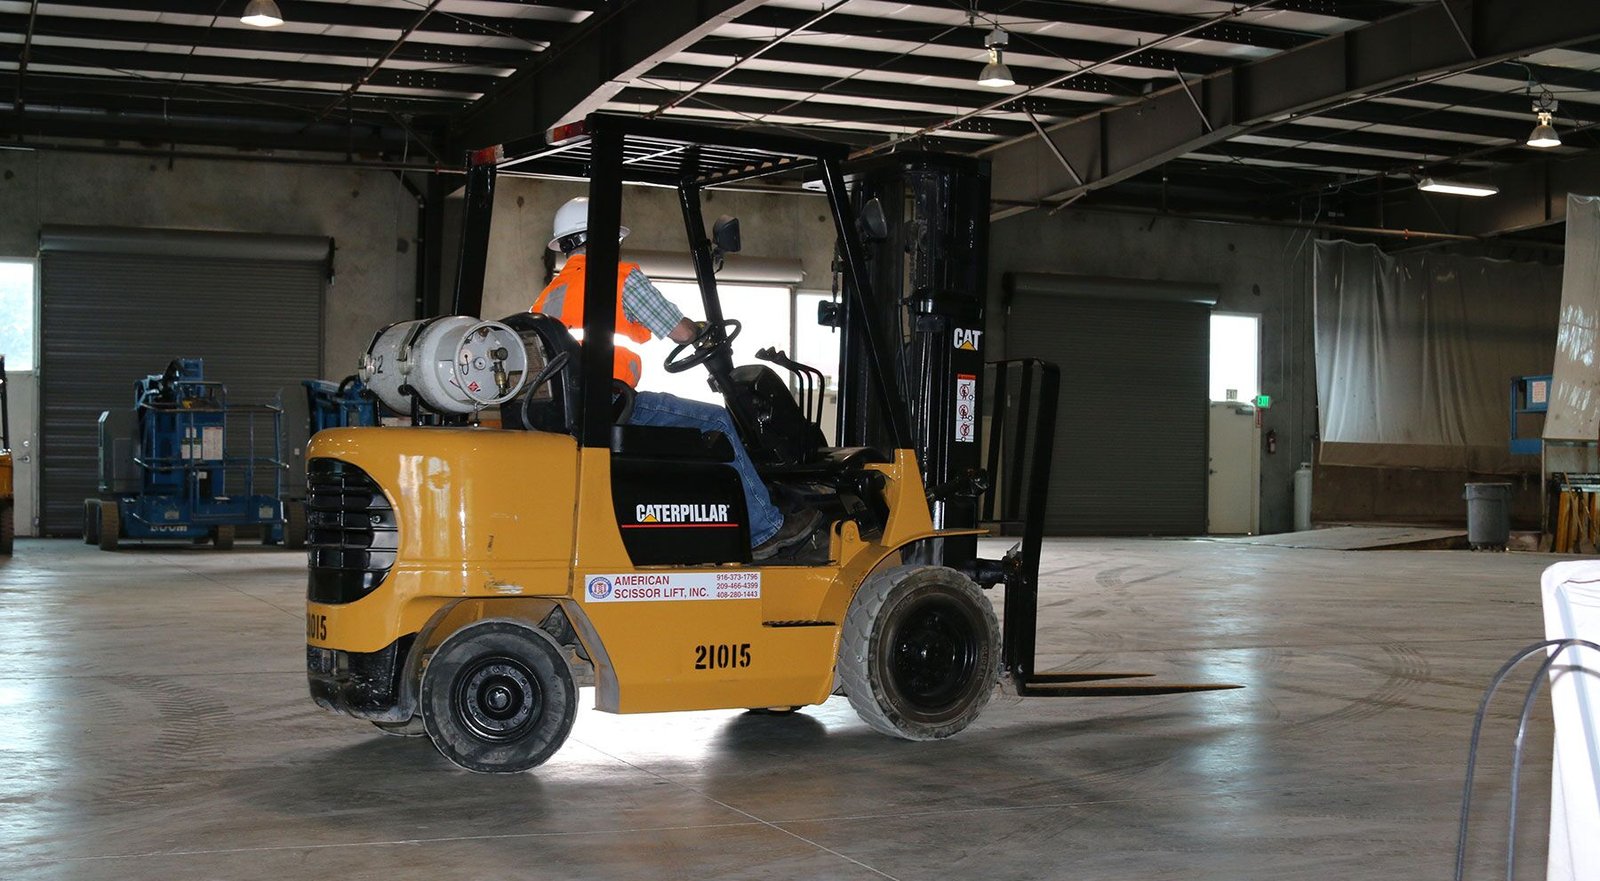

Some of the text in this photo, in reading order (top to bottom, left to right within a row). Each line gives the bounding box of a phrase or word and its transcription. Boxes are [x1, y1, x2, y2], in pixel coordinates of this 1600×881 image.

[954, 328, 981, 350] CAT
[636, 504, 728, 522] CATERPILLAR
[614, 576, 670, 586] AMERICAN
[716, 582, 758, 590] 209-466-4399
[614, 588, 661, 599] SCISSOR
[663, 588, 687, 599] LIFT,
[689, 587, 709, 598] INC.
[695, 643, 751, 670] 21015
